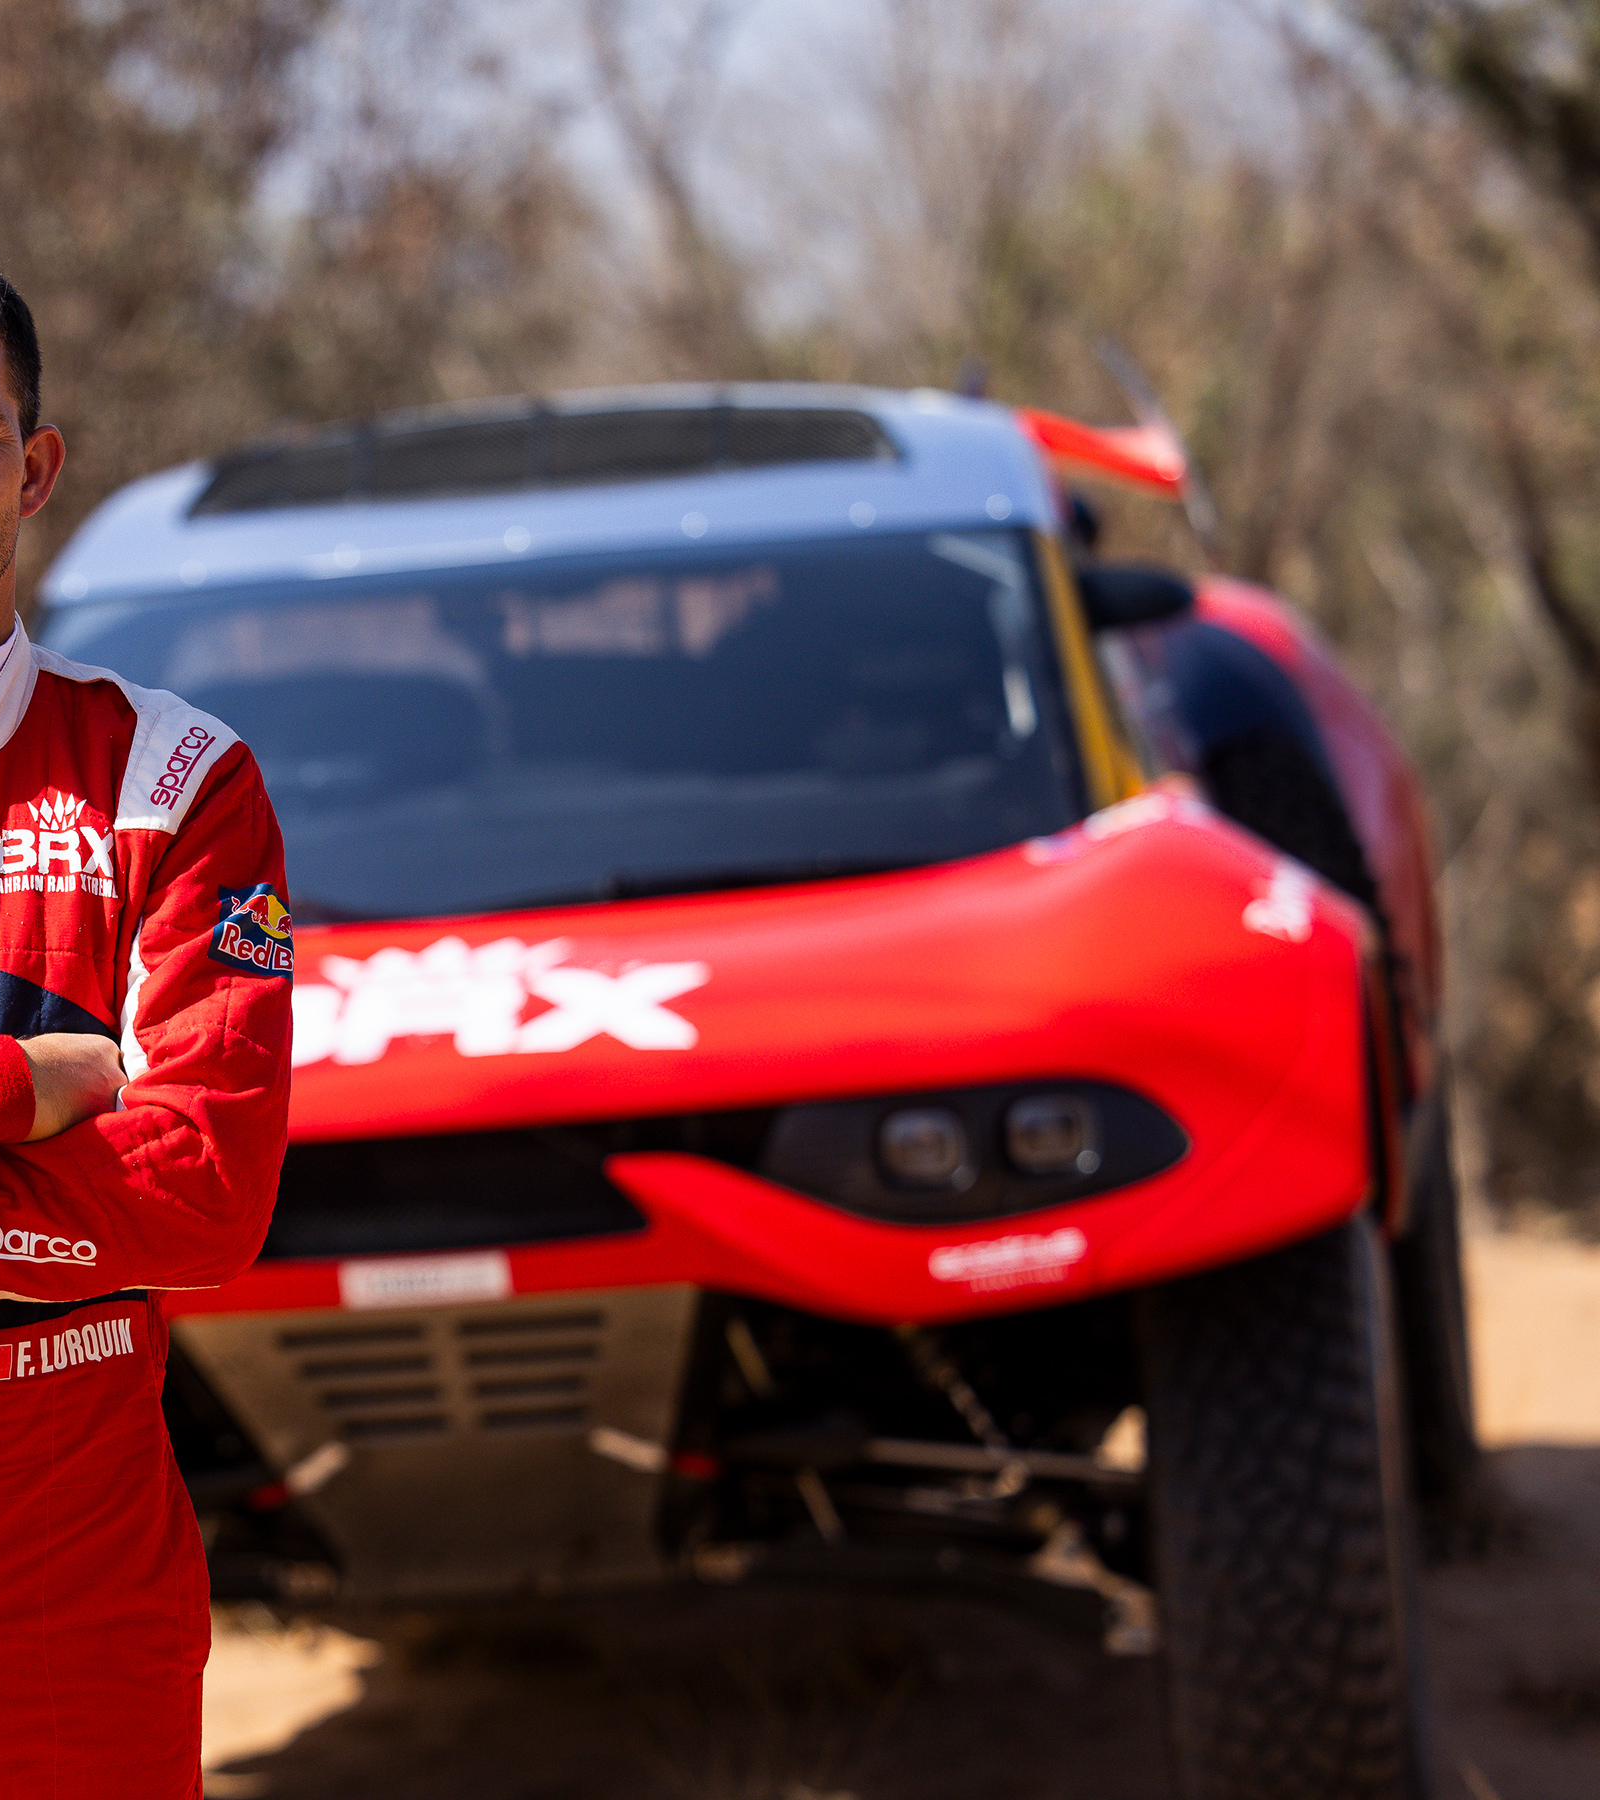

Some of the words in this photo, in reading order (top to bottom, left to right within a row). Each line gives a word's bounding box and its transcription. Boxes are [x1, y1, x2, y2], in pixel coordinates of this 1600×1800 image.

[150, 725, 216, 811] sparco
[47, 874, 77, 893] RAID
[217, 921, 274, 970] Red
[16, 1340, 36, 1378] F.
[39, 1317, 135, 1374] LURQUIN
